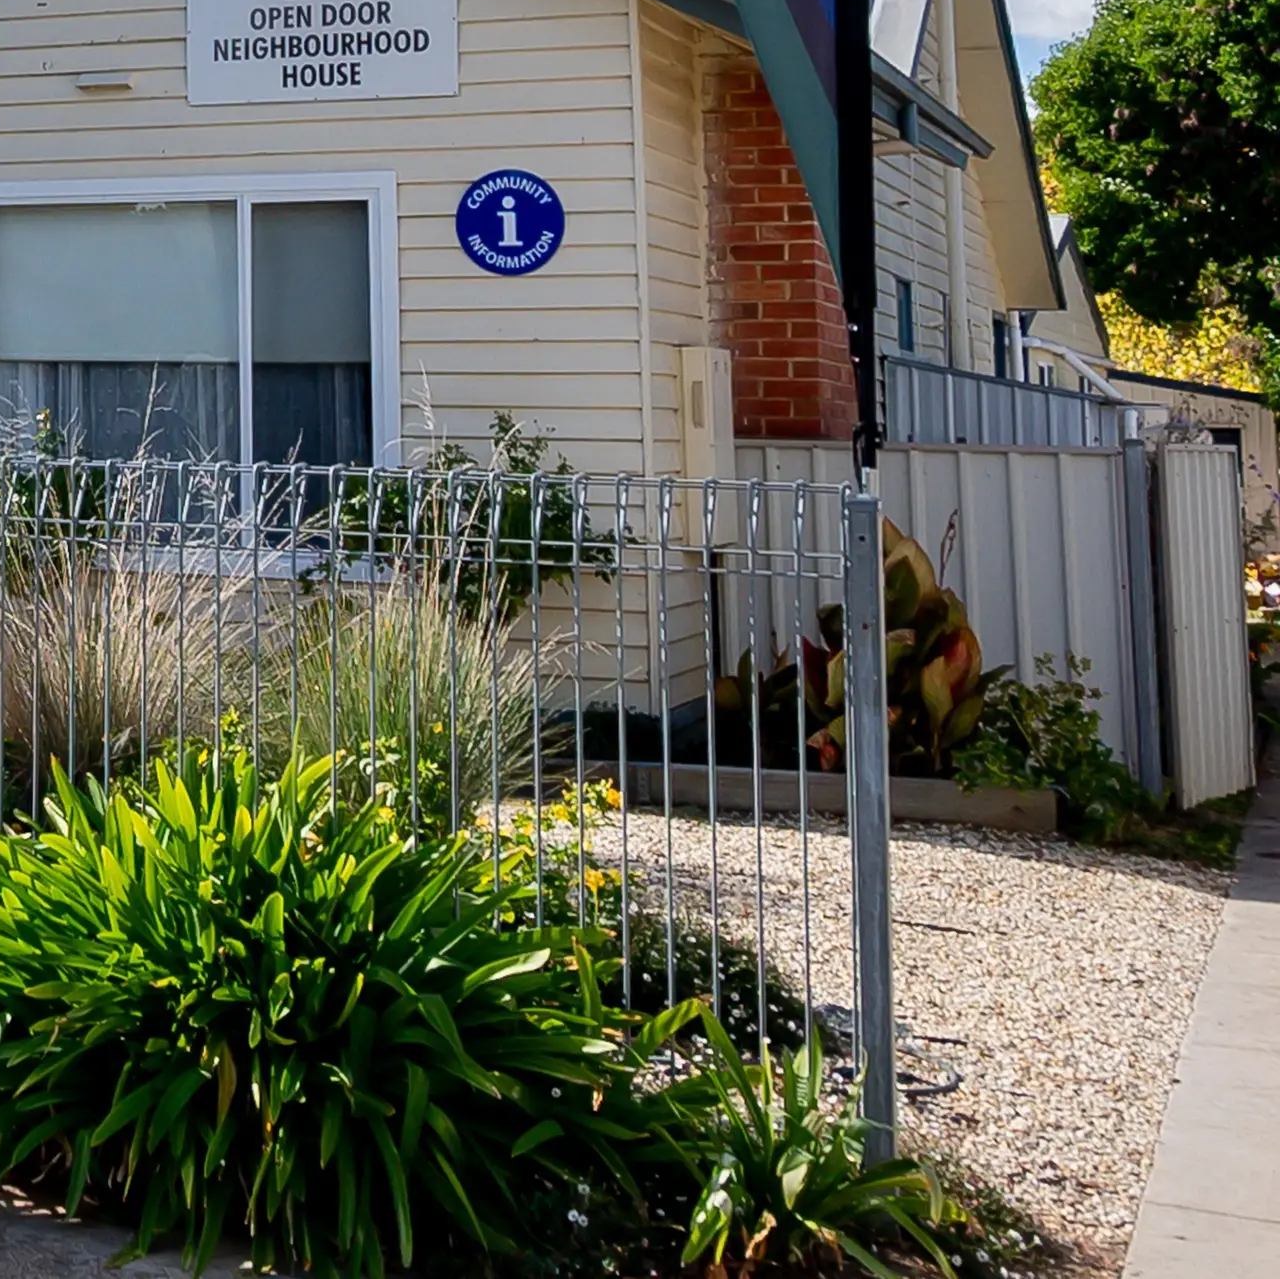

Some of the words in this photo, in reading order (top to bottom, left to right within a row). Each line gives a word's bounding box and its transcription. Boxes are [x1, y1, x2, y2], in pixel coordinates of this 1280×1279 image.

[249, 4, 312, 31] OPEN
[320, 0, 392, 27] DOOR
[213, 28, 430, 62] NEIGHBOURHOOD
[281, 61, 361, 88] HOUSE
[467, 176, 552, 209] COMMUNITY
[467, 230, 555, 269] INFORMATION
